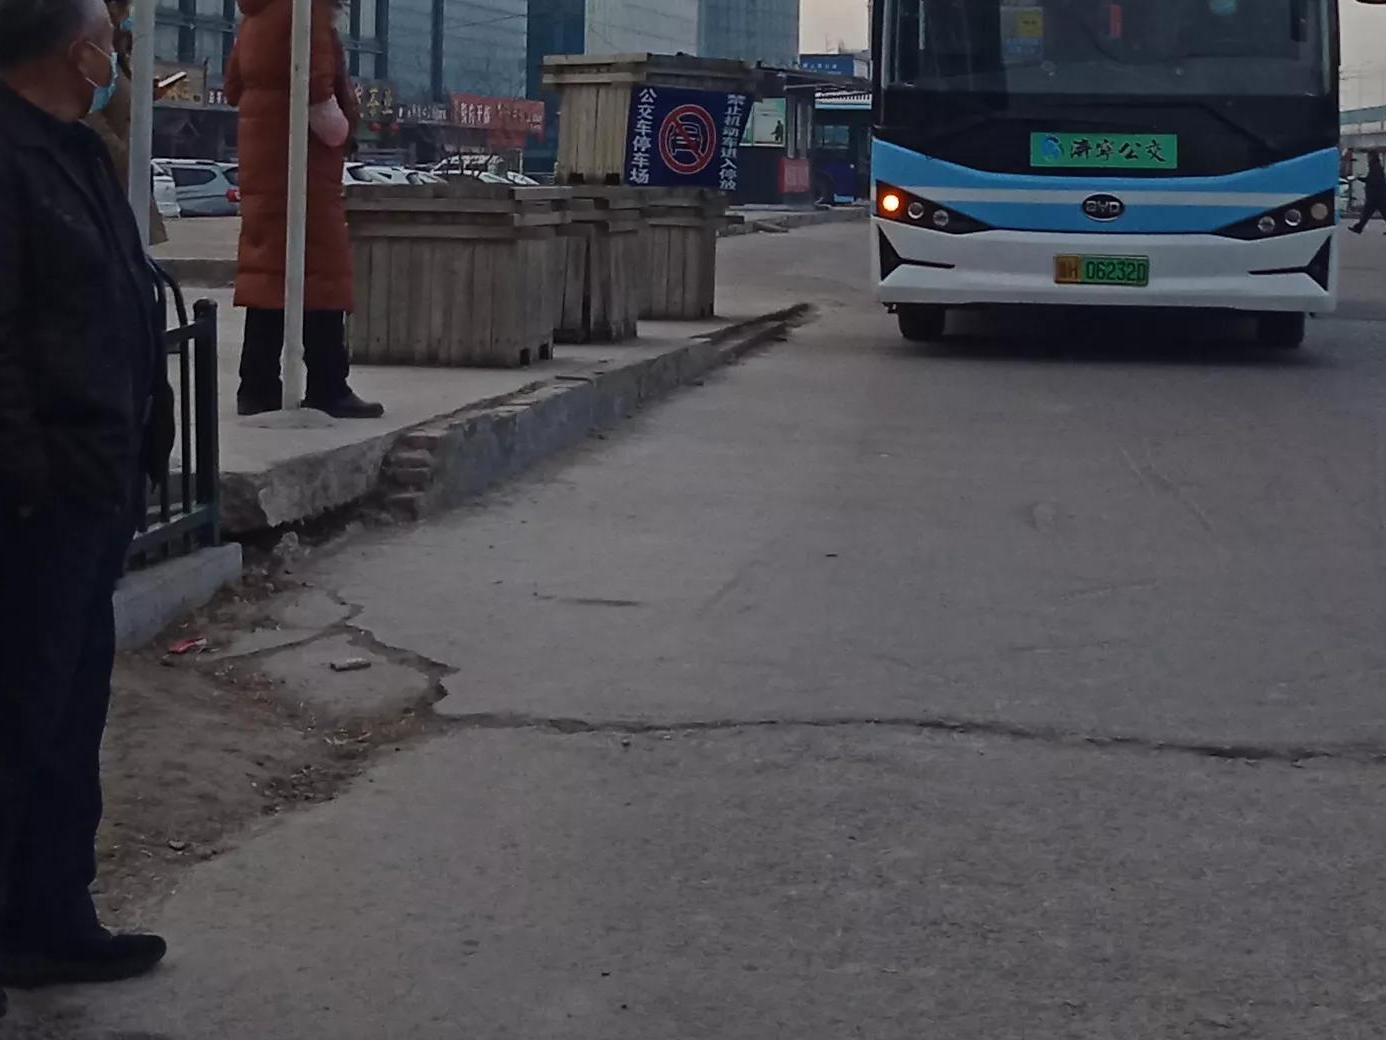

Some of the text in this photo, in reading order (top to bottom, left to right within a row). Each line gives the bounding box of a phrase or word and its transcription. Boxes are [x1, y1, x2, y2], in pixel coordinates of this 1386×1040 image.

[629, 87, 658, 185] 公交车停车场
[1086, 200, 1120, 213] BYD
